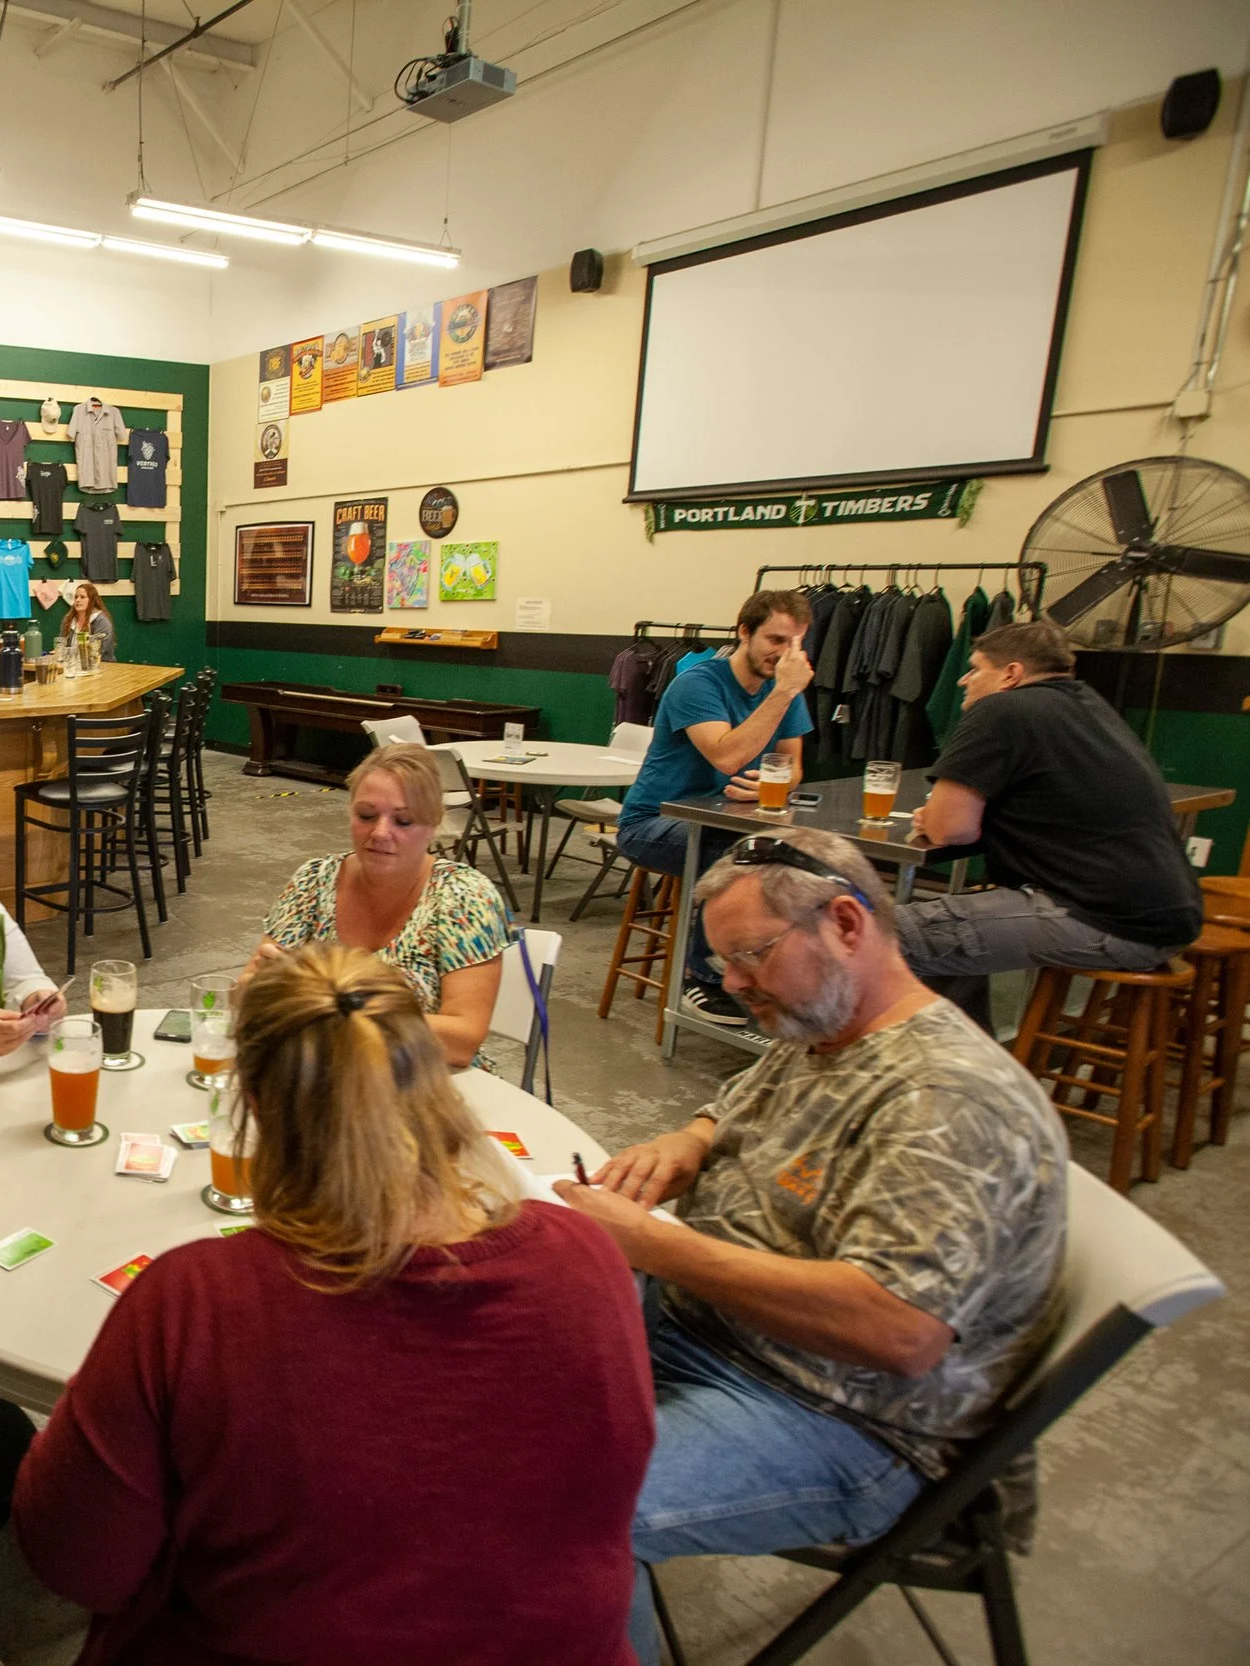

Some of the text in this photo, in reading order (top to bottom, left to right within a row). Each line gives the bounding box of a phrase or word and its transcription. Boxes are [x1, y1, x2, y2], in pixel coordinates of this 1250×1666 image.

[336, 504, 386, 524] CRAFT BEER
[673, 504, 787, 524] PORTLAND
[822, 492, 933, 518] TIMBERS
